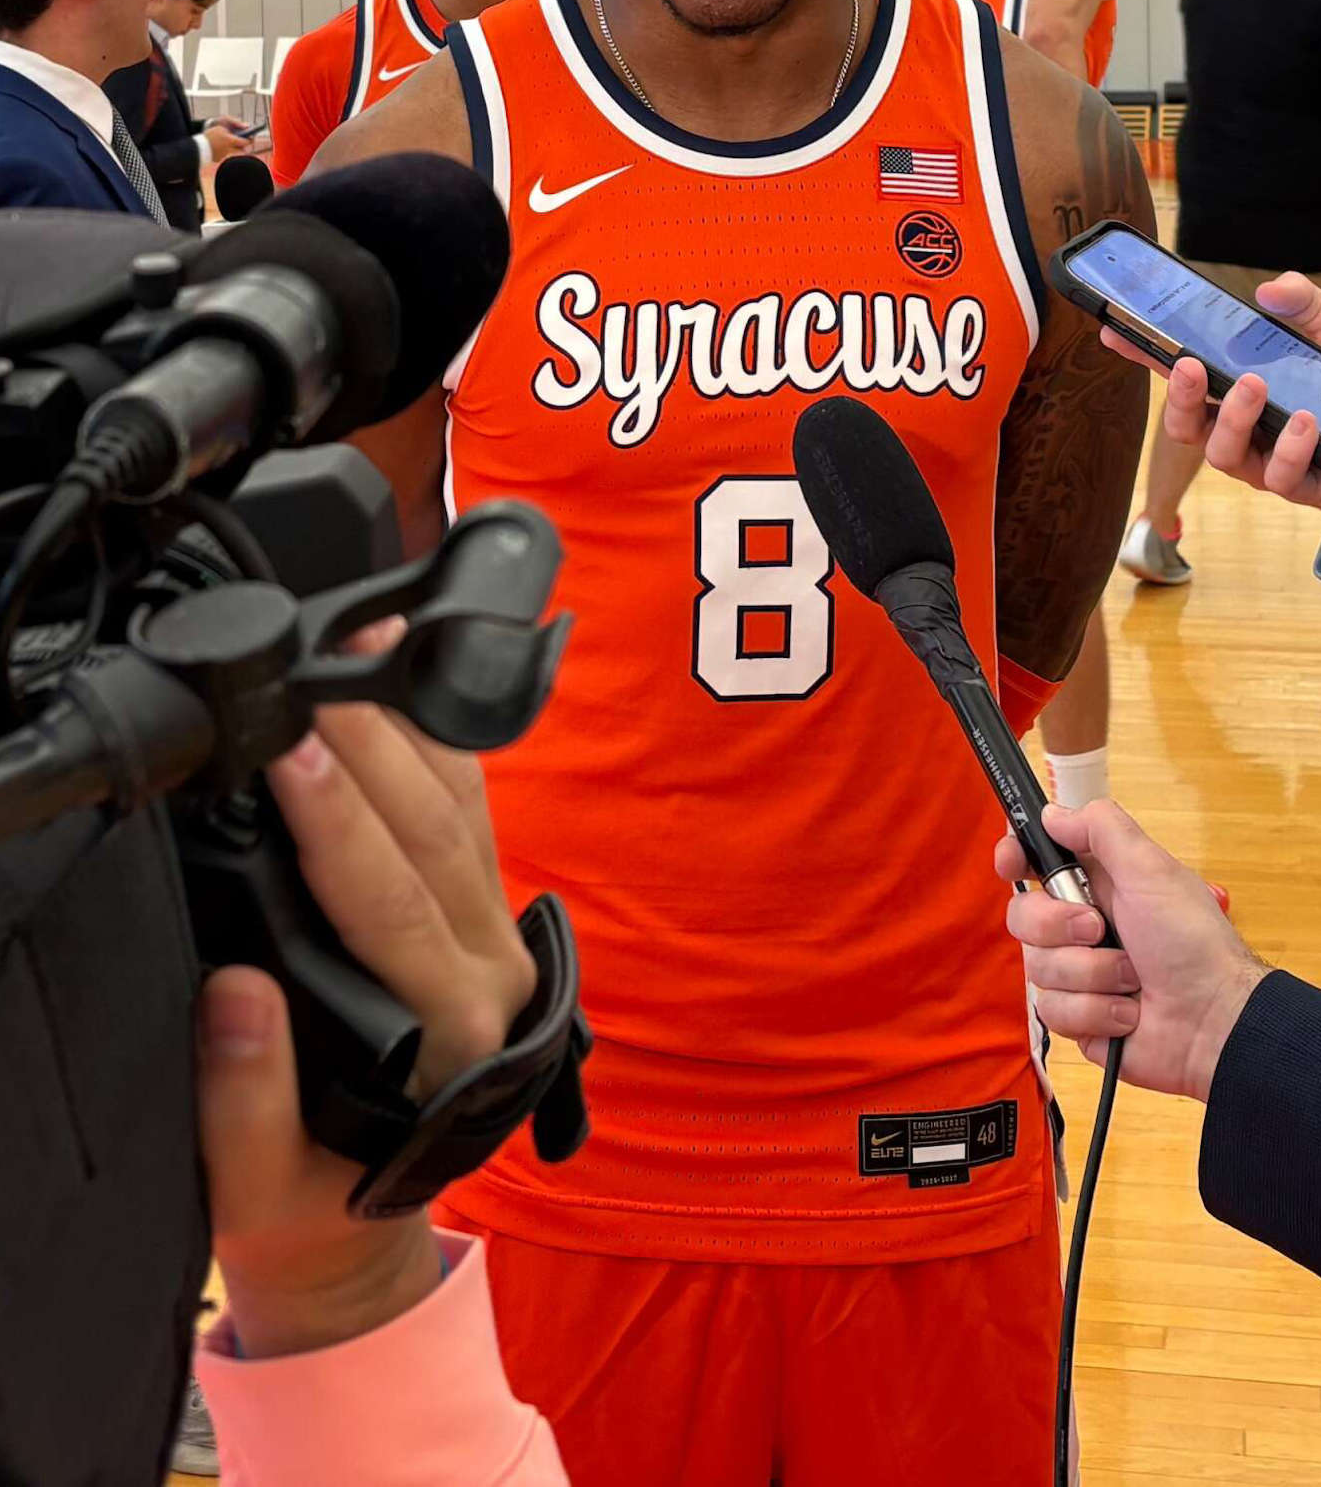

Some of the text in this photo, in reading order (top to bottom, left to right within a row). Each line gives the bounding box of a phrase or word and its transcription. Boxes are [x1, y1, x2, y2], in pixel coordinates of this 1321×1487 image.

[908, 233, 955, 248] ACC
[530, 270, 986, 448] Syracuse
[691, 474, 834, 702] 8
[973, 728, 1015, 804] SENNHEISER
[977, 1121, 997, 1146] 48
